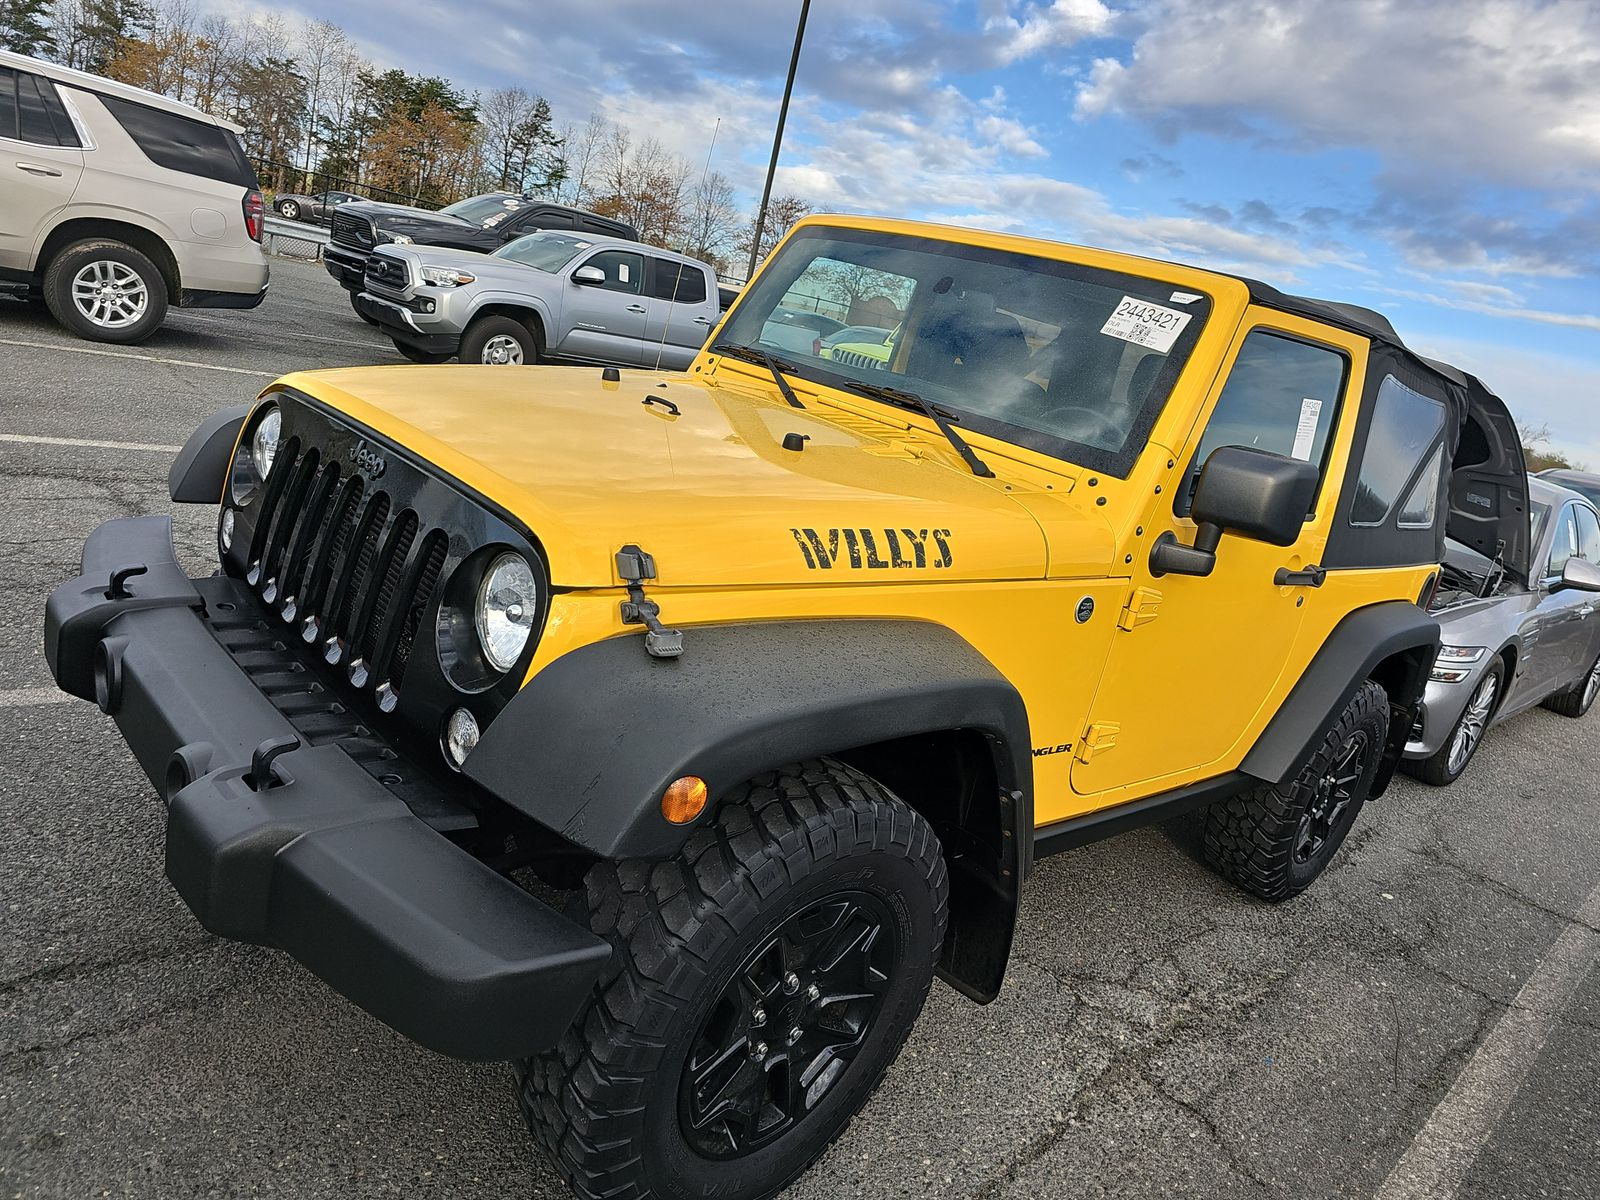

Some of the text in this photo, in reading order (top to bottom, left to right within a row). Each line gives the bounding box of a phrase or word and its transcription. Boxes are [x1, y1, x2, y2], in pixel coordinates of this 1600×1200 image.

[1116, 302, 1181, 331] 2443421
[350, 440, 385, 479] Jeep
[789, 528, 953, 569] WILLYS
